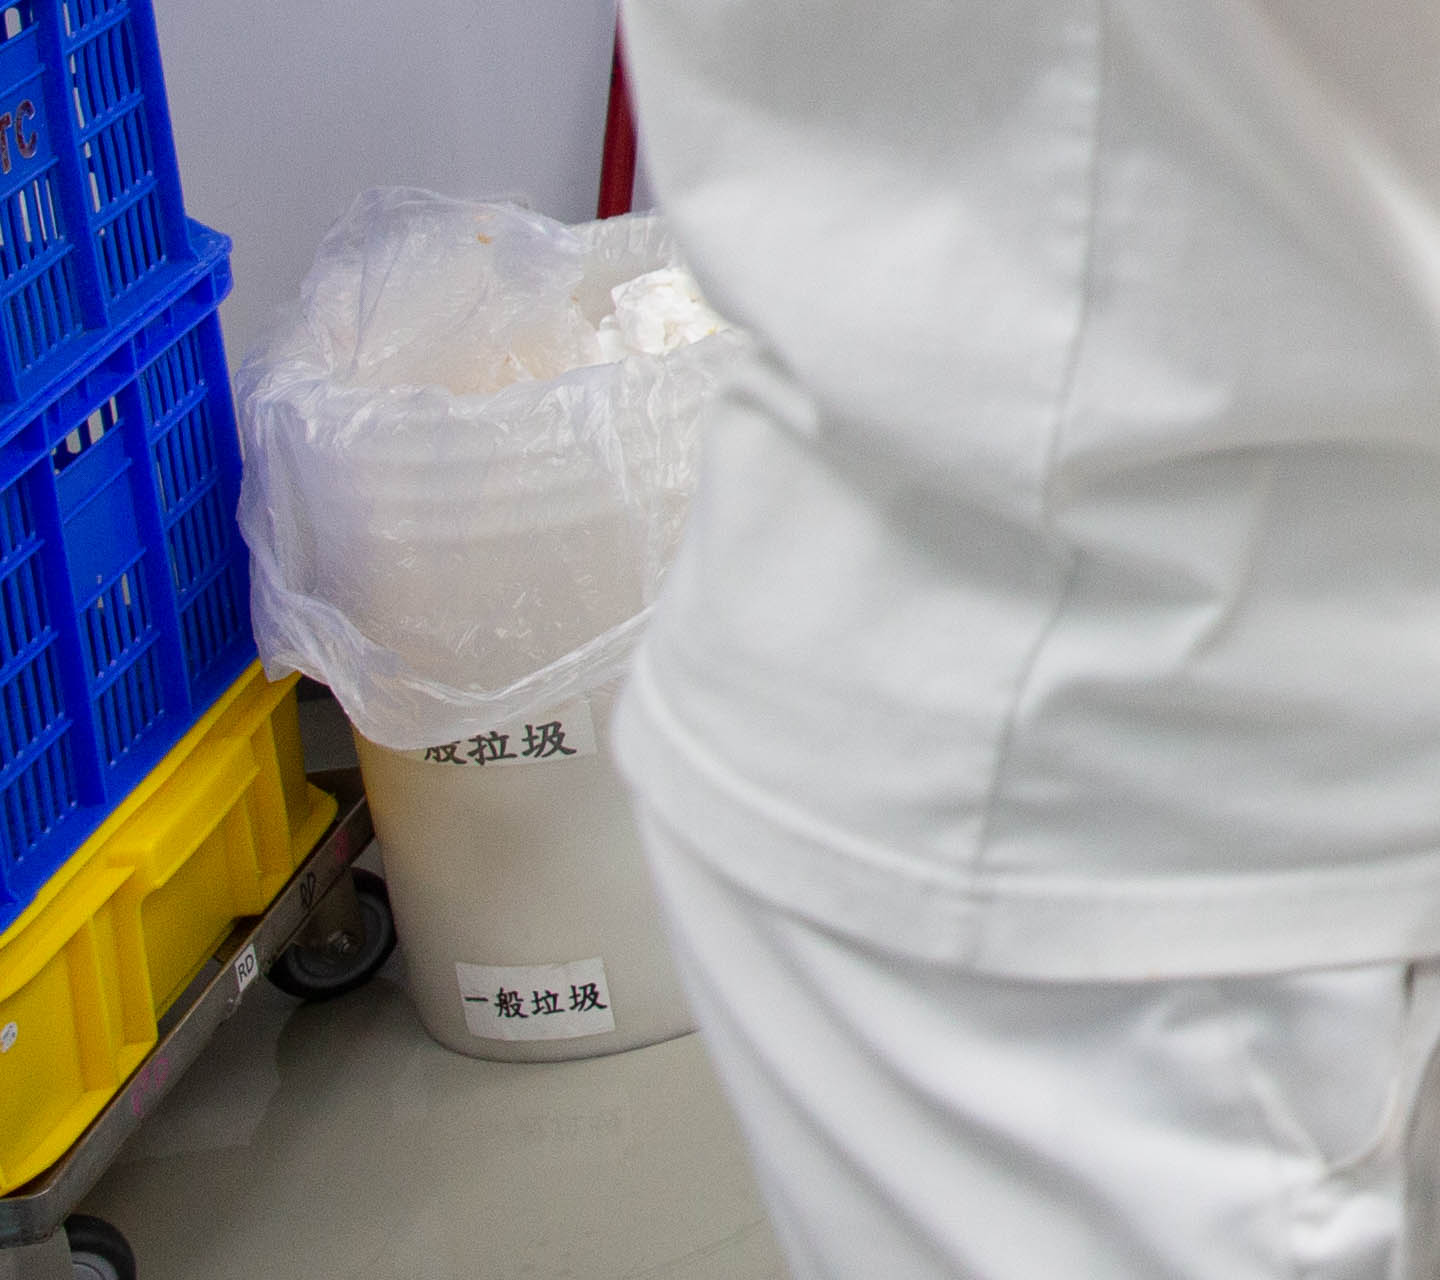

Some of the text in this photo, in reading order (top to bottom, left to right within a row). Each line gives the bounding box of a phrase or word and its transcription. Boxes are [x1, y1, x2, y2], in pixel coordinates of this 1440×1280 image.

[237, 953, 256, 983] RD
[464, 982, 608, 1019] 一般垃圾
